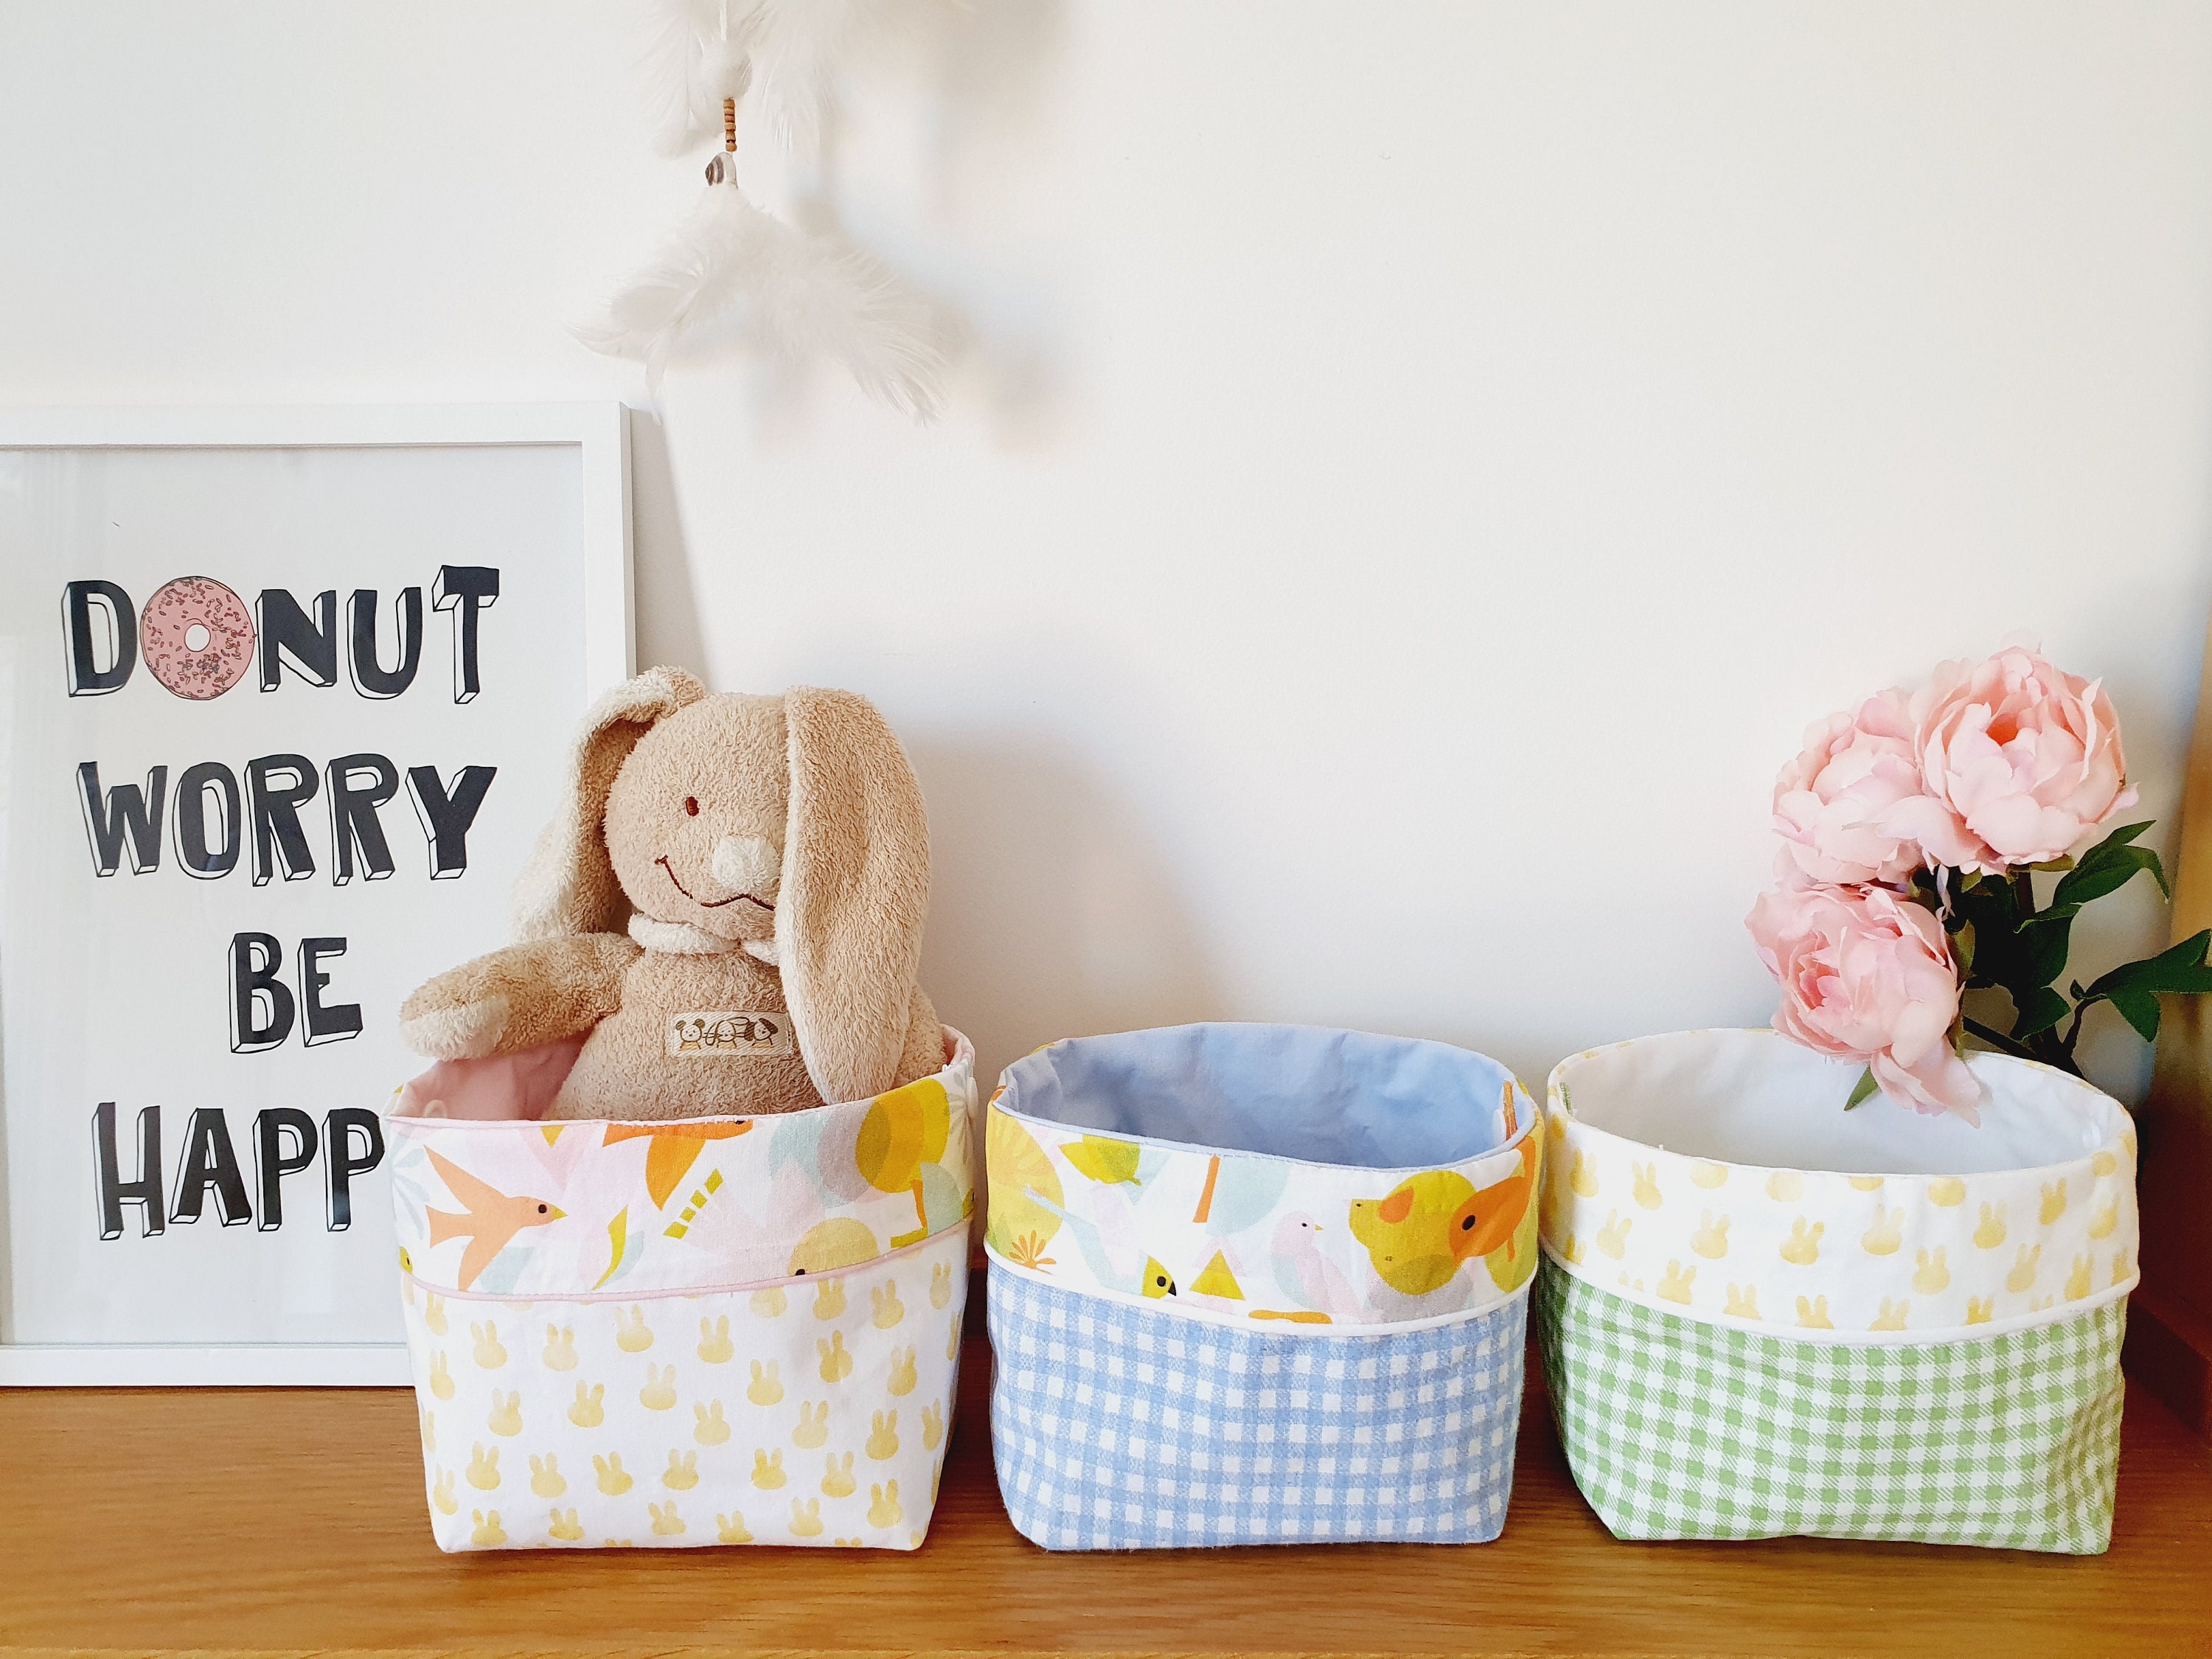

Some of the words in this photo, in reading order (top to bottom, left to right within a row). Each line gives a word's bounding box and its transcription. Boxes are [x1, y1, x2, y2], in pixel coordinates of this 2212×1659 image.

[61, 565, 499, 704] DONUT
[77, 754, 497, 887] WORRY
[229, 932, 363, 1054] BE
[92, 1102, 385, 1240] HAPP
